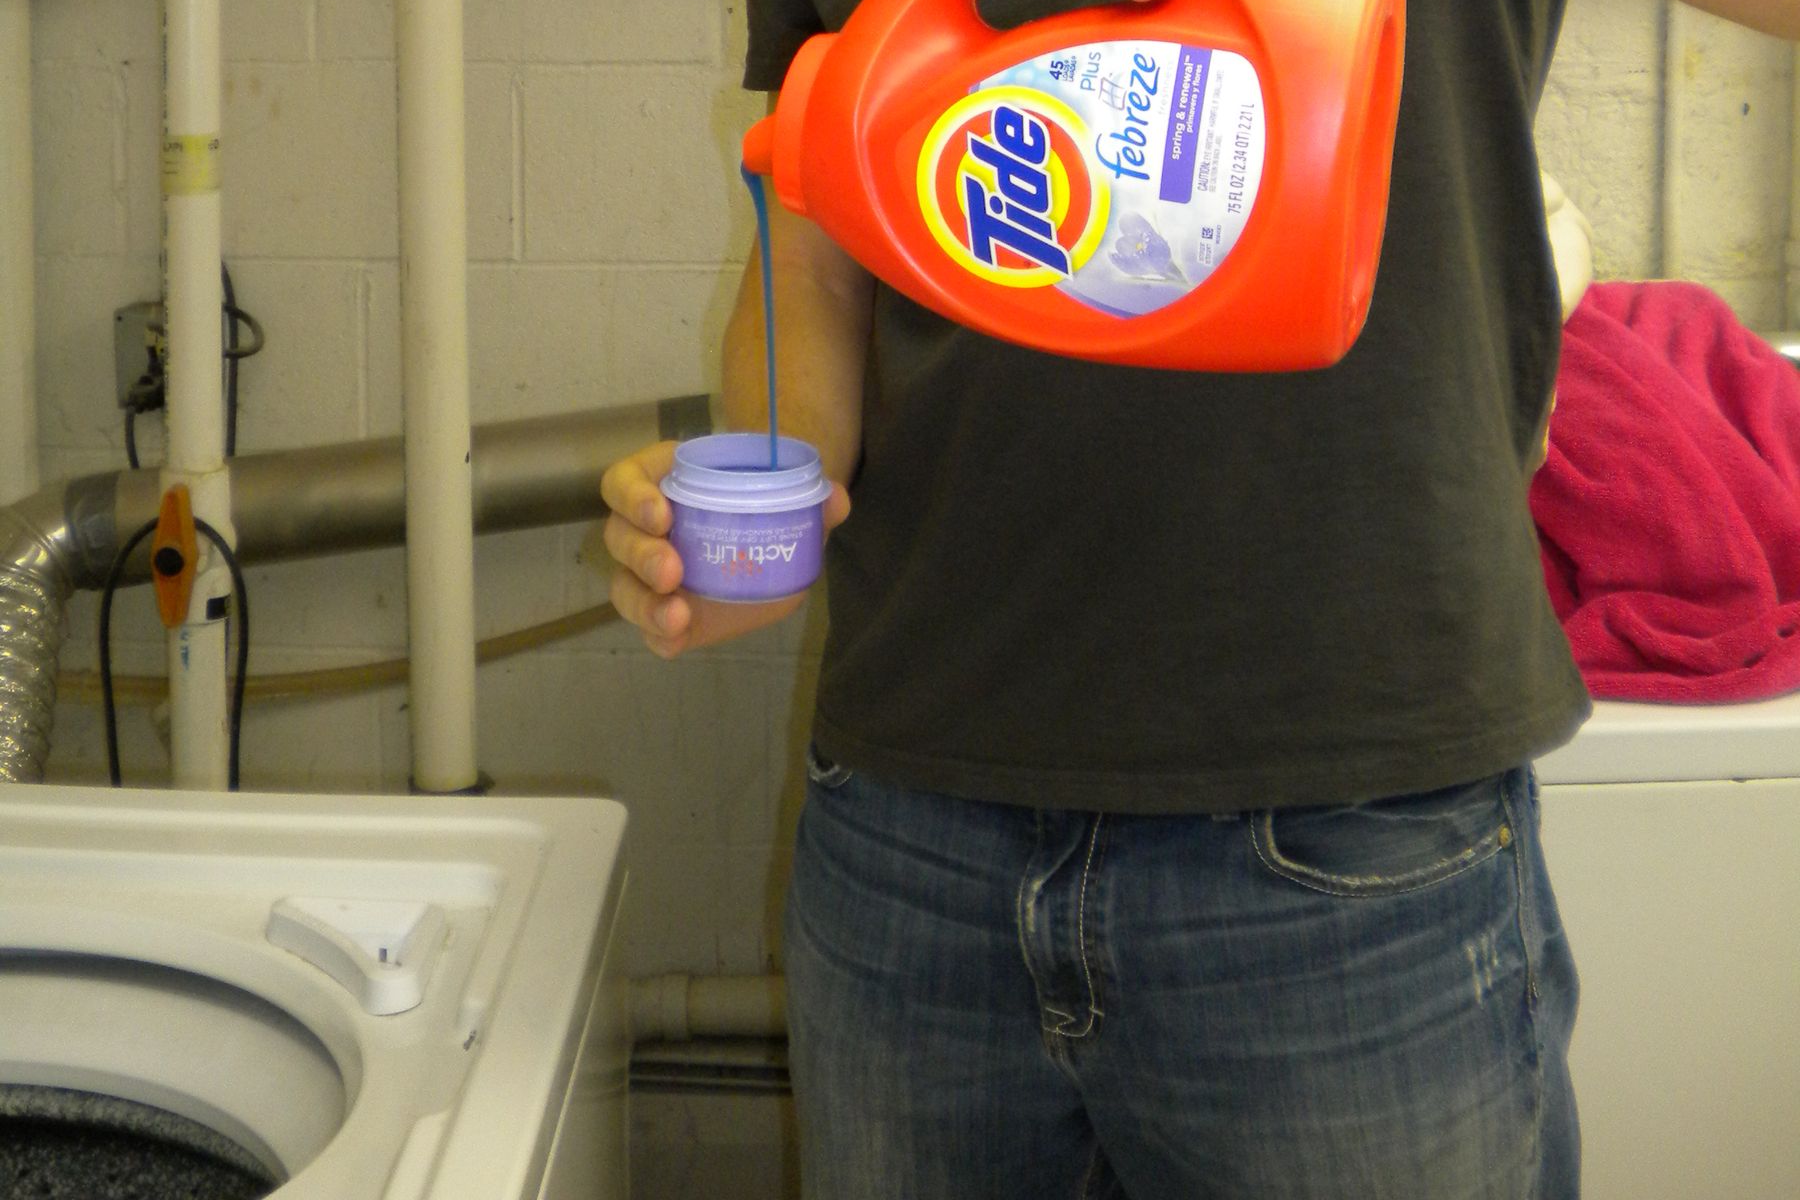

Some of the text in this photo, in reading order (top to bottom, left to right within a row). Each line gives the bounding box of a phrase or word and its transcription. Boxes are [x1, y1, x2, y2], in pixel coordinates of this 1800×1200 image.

[1049, 60, 1064, 80] 45
[1080, 51, 1101, 91] Plus
[1186, 94, 1198, 134] primavera
[1192, 64, 1203, 87] flores
[1096, 53, 1160, 180] febreze
[1176, 111, 1186, 121] &
[1238, 110, 1253, 130] 2.21
[1172, 122, 1186, 160] spring
[963, 103, 1072, 278] Tide
[1230, 174, 1245, 188] OZ
[1228, 191, 1243, 202] FL
[1228, 203, 1241, 214] 75
